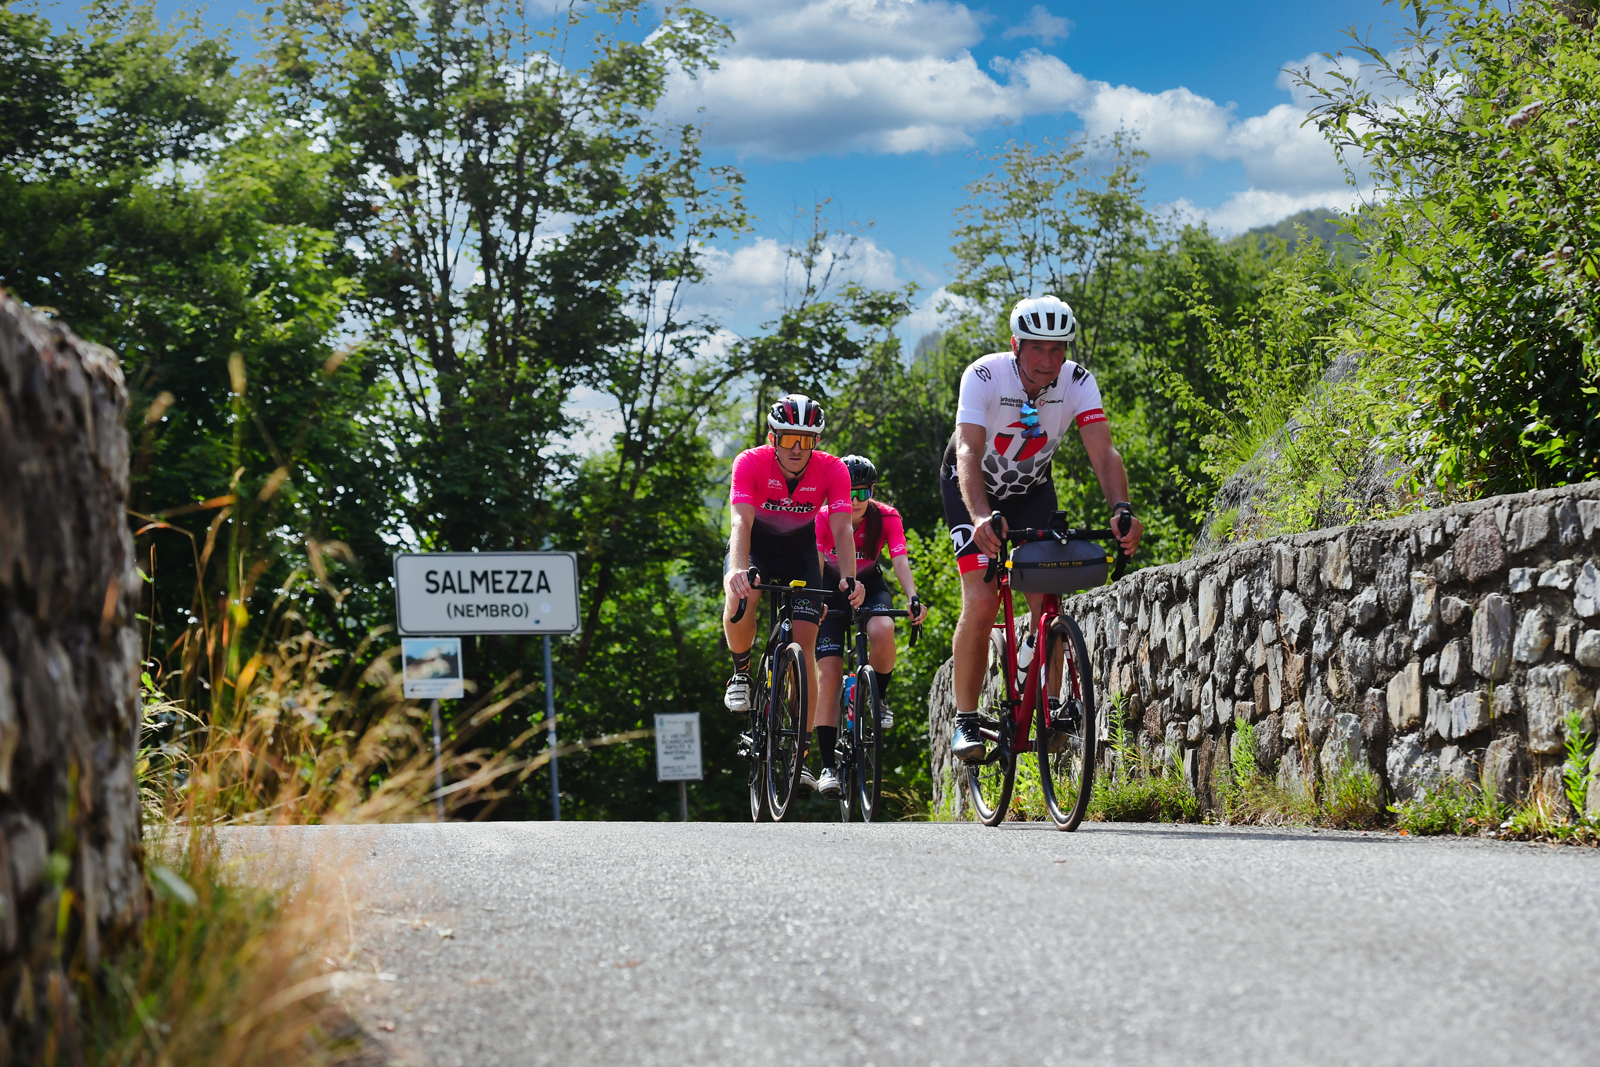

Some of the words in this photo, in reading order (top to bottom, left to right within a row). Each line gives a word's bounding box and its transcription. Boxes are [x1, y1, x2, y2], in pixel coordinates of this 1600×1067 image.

[764, 503, 814, 513] SELVINO
[425, 570, 551, 595] SALMEZZA
[447, 602, 529, 619] (NEMBRO)
